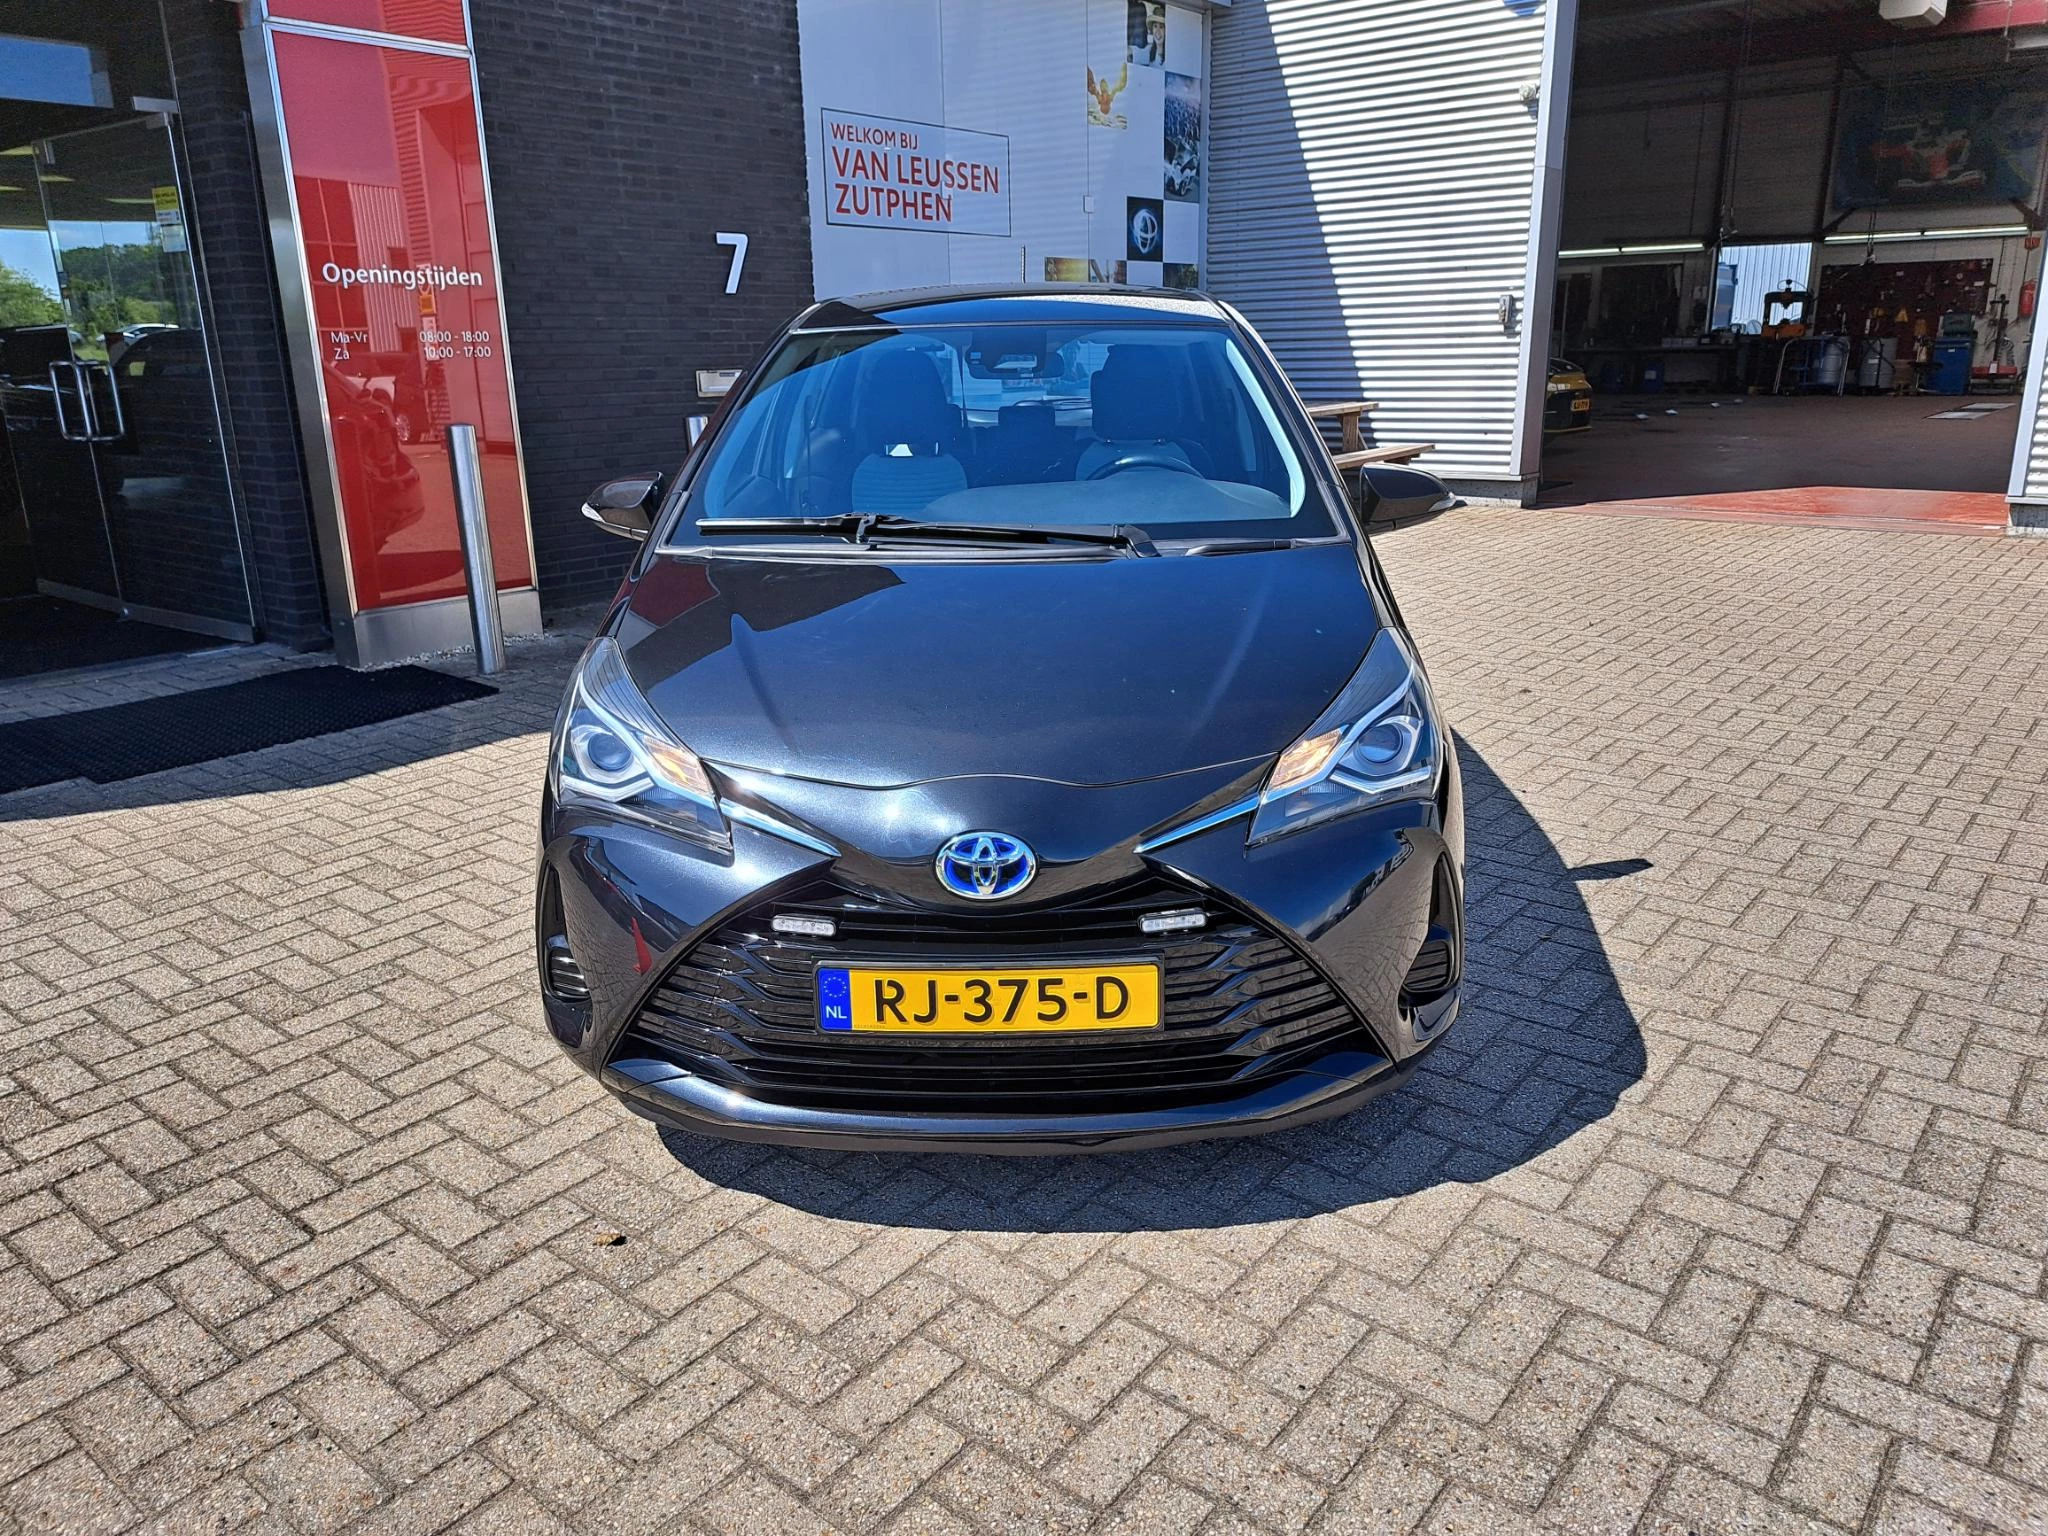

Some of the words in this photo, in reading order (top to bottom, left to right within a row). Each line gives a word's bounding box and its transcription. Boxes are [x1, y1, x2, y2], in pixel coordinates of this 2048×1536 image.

[831, 122, 896, 147] WELKOM
[901, 133, 918, 150] BIJ
[832, 146, 889, 182] VAN
[897, 154, 999, 194] LEUSSEN
[835, 183, 952, 222] ZUTPHEN
[322, 263, 483, 291] Openingstijden
[715, 232, 748, 294] 7
[331, 331, 368, 344] Ma-Vr
[419, 331, 452, 343] 08:00
[462, 331, 490, 342] 18:00
[334, 349, 350, 360] Za
[424, 346, 453, 358] 10:00
[464, 346, 491, 358] 17:00
[825, 1005, 848, 1019] NL
[874, 975, 1129, 1023] RJ-375-D
